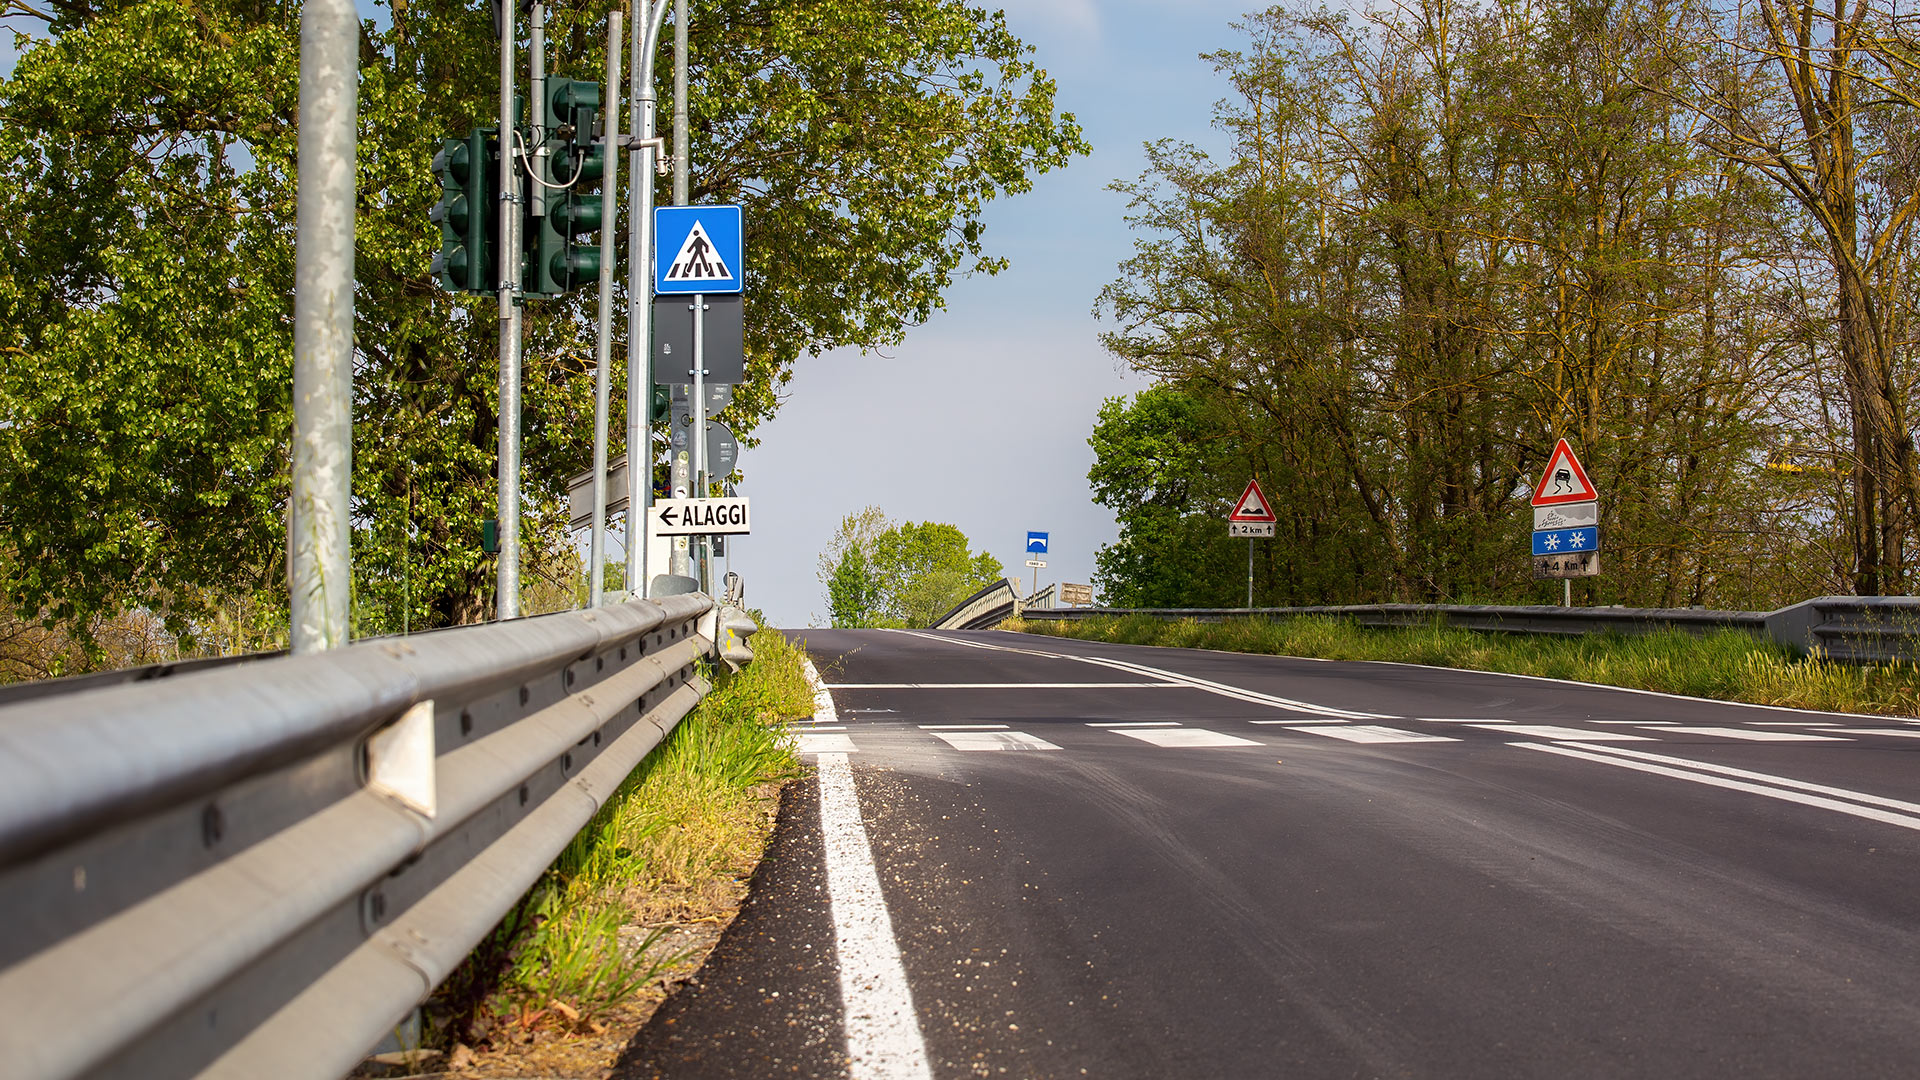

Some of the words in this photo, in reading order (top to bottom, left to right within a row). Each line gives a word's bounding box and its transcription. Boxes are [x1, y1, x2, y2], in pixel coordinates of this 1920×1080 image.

[682, 504, 746, 526] ALAGGI
[1241, 525, 1248, 534] 2
[1250, 526, 1262, 534] km
[1552, 561, 1560, 572] 4
